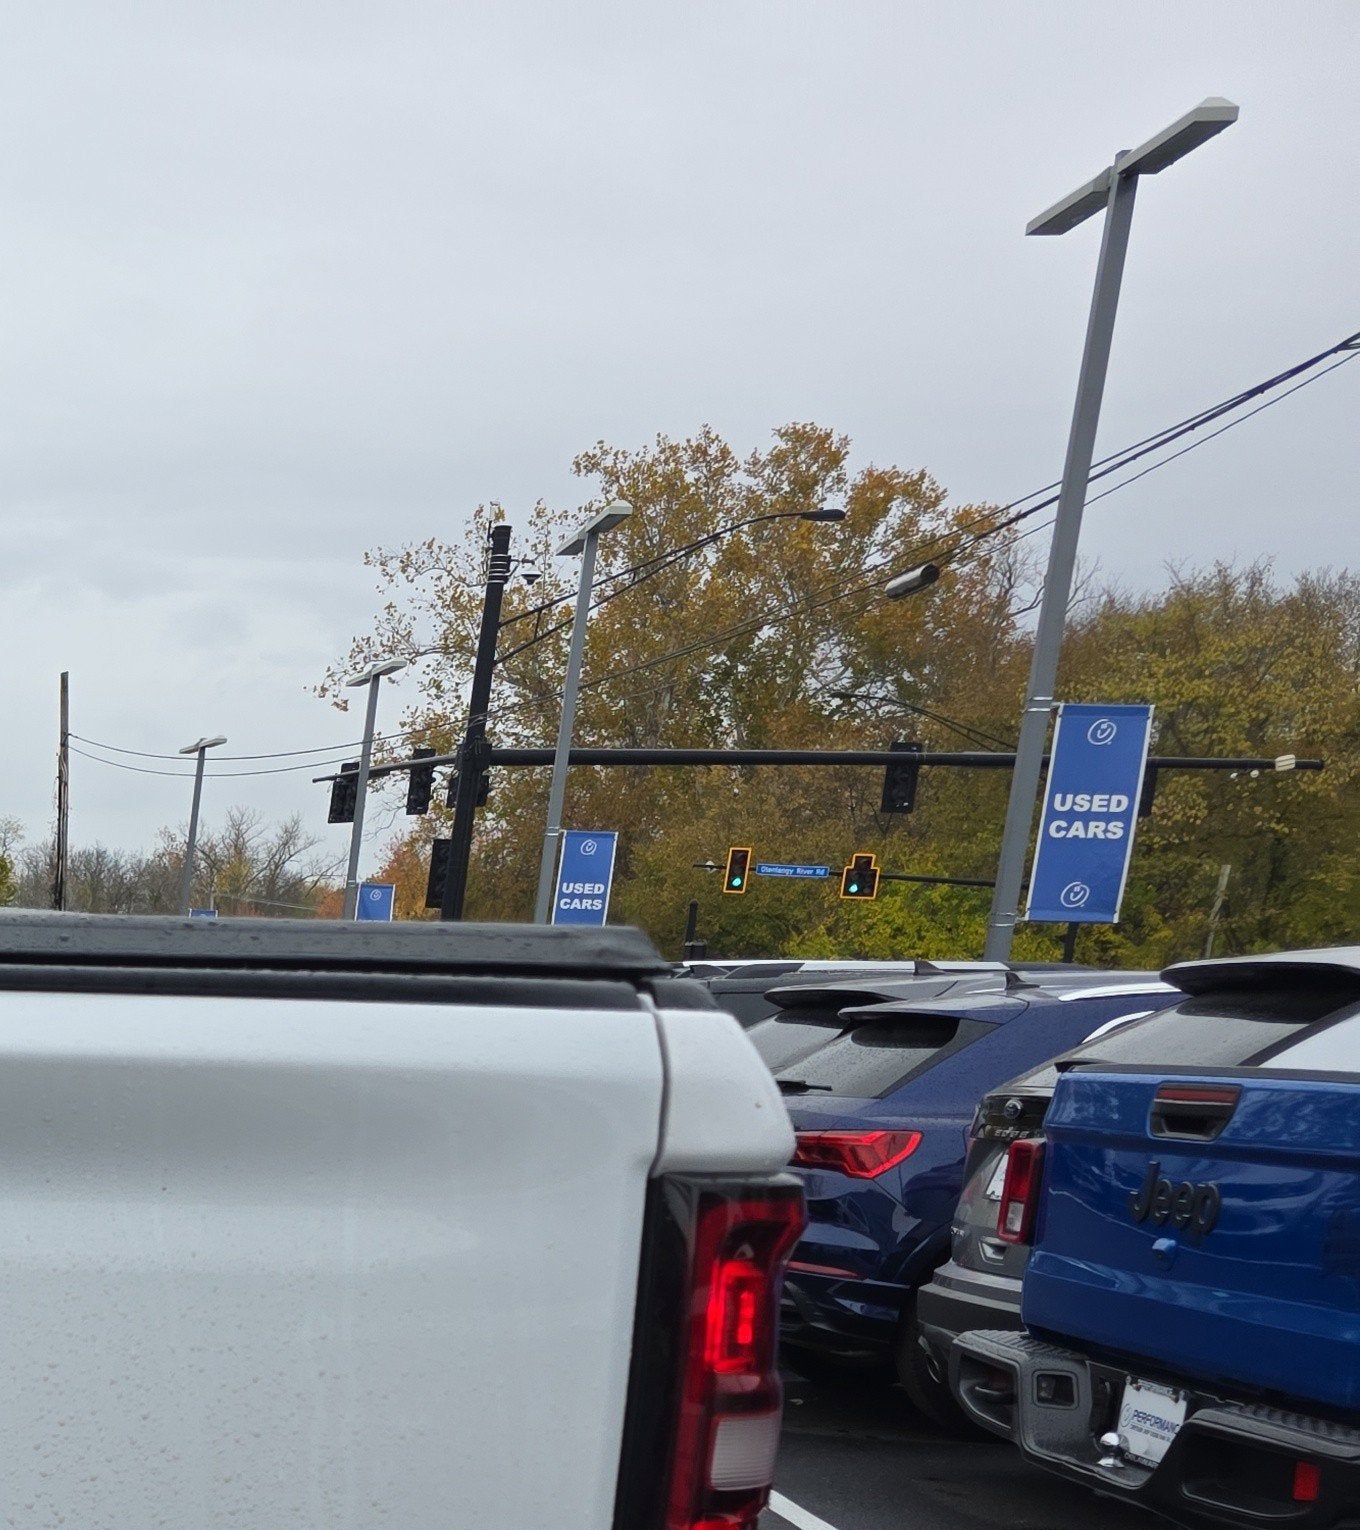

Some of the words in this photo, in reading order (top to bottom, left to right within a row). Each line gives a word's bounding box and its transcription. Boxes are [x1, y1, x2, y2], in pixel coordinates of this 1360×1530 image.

[1053, 793, 1129, 813] USED
[1049, 820, 1124, 839] CARS
[796, 867, 814, 875] River
[562, 883, 605, 895] USED
[559, 898, 603, 910] CARS
[1129, 1161, 1221, 1242] Jeep
